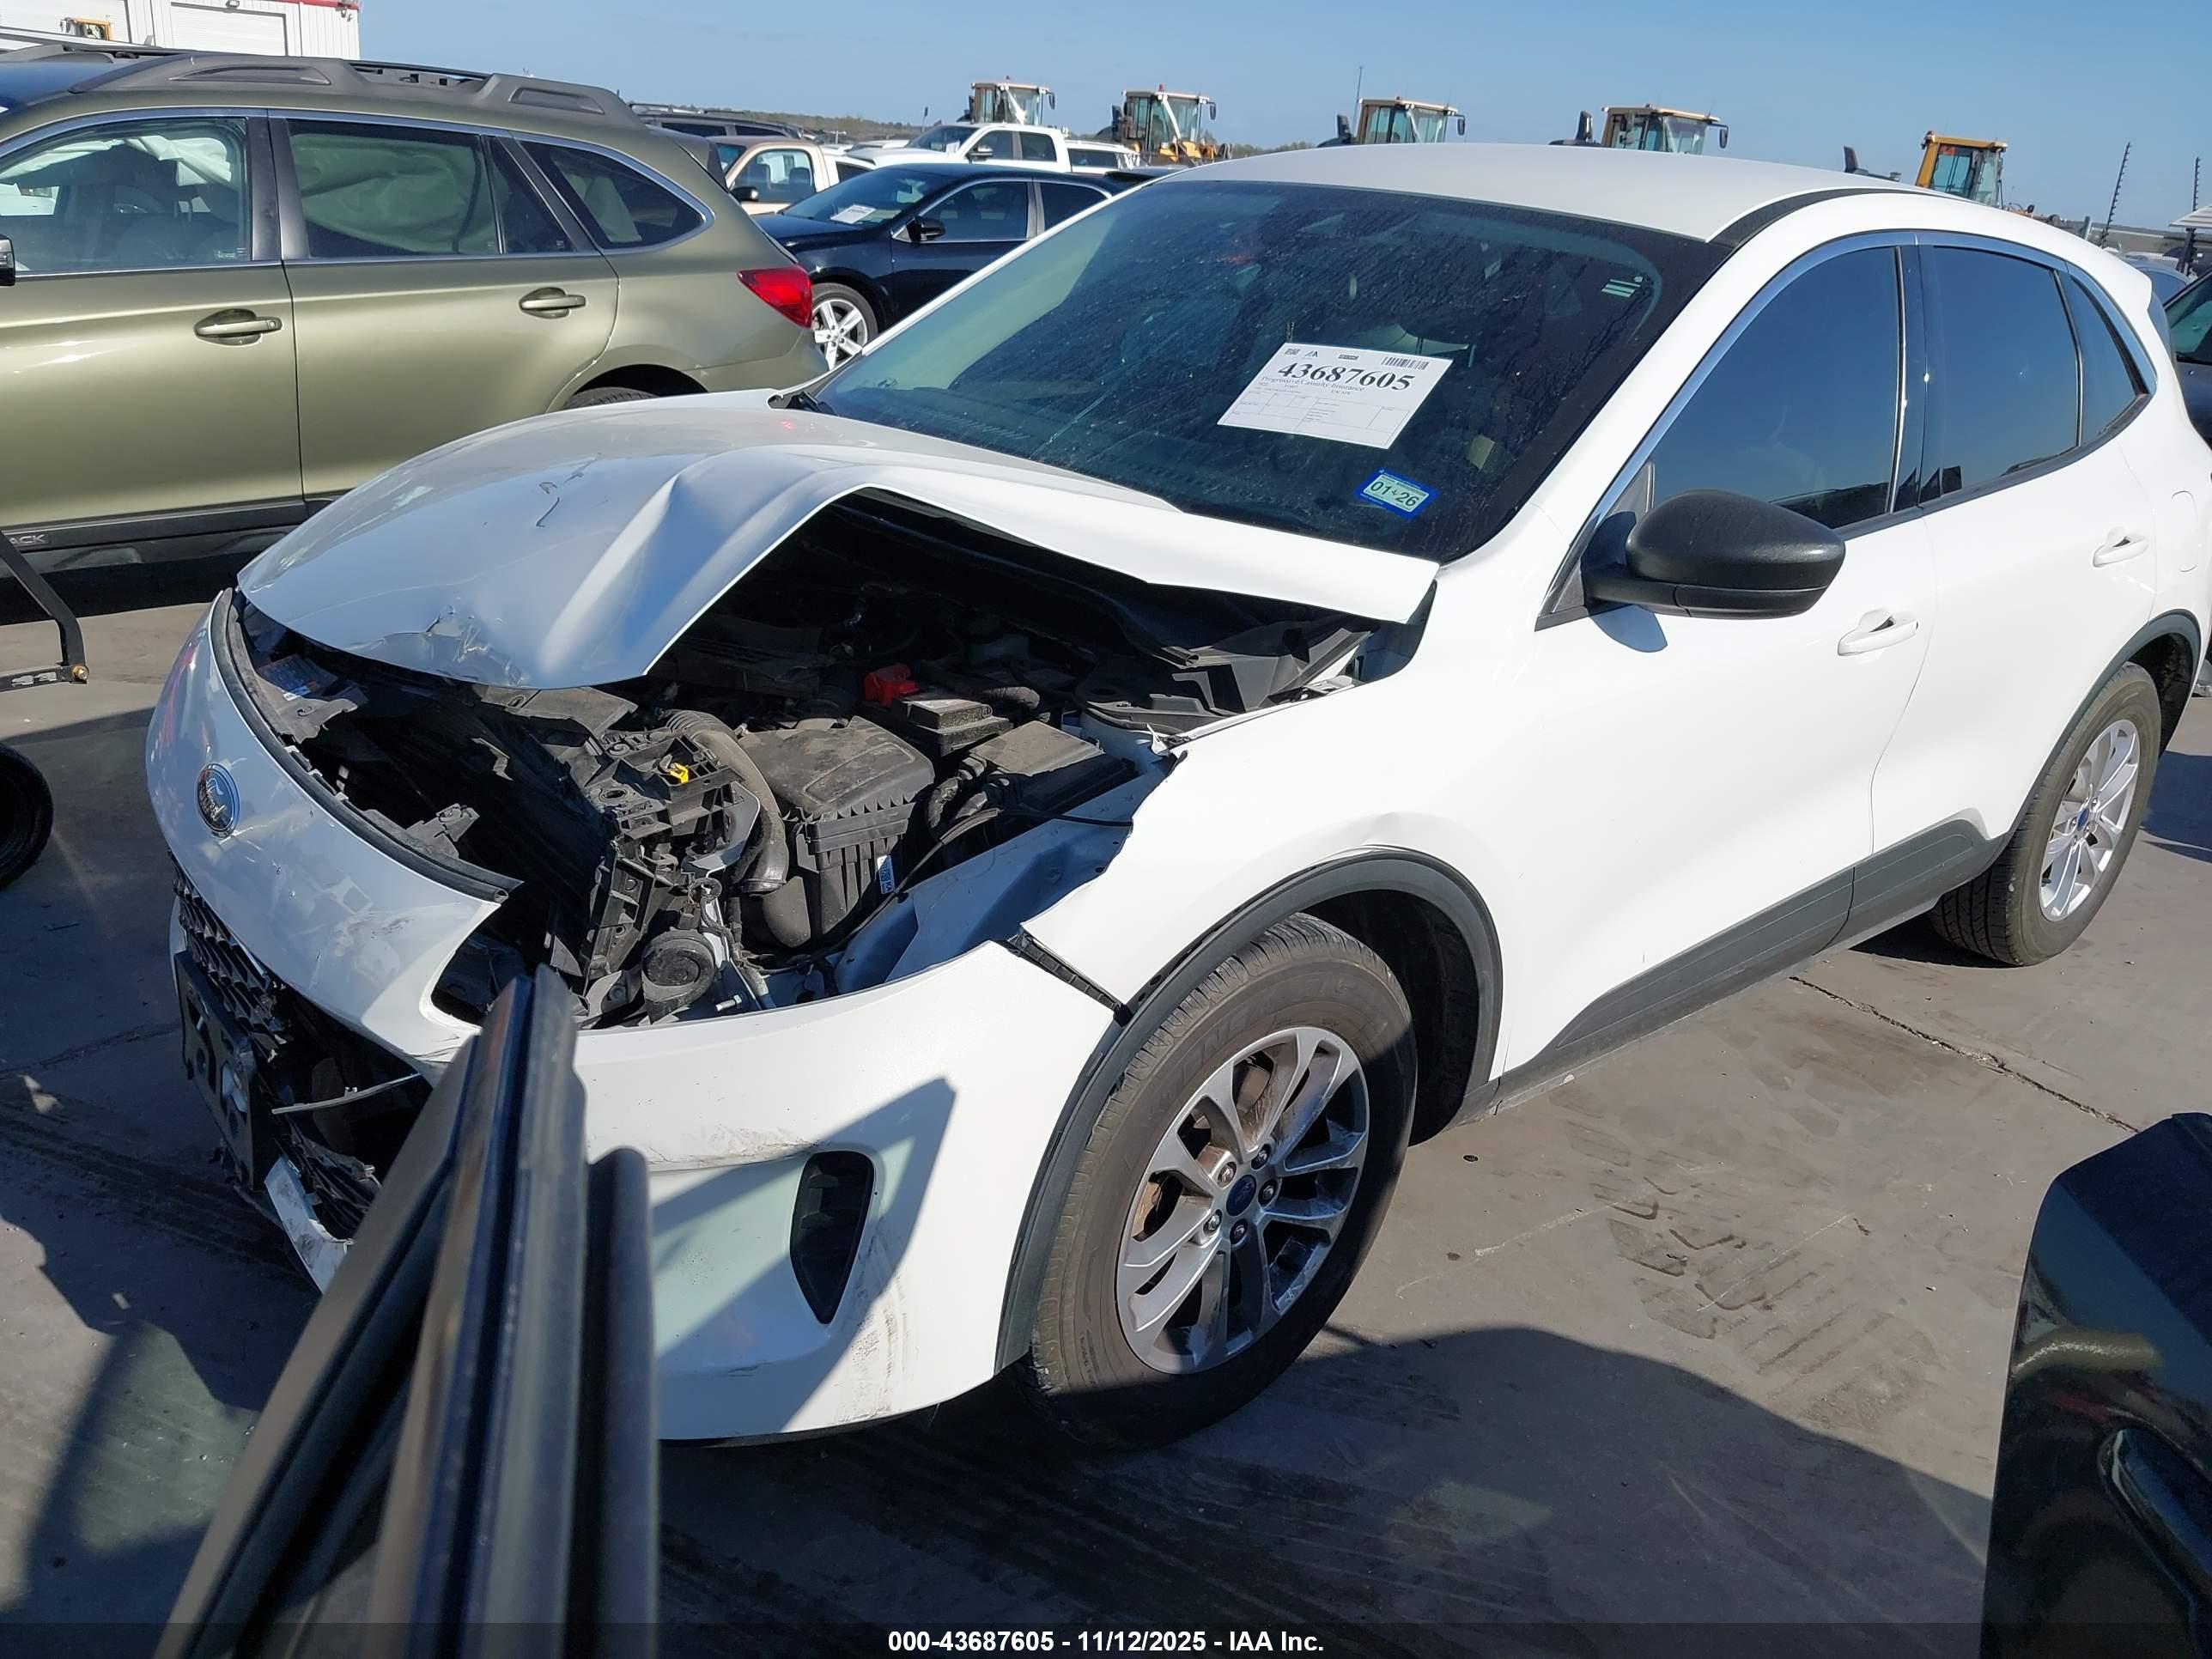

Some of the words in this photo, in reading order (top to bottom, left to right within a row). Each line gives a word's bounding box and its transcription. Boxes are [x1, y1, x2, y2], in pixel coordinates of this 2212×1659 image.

[1277, 362, 1415, 391] 43687605
[1300, 380, 1328, 388] Casualty
[1331, 383, 1365, 392] Insurance
[1370, 481, 1393, 495] 01
[1395, 492, 1419, 507] 26
